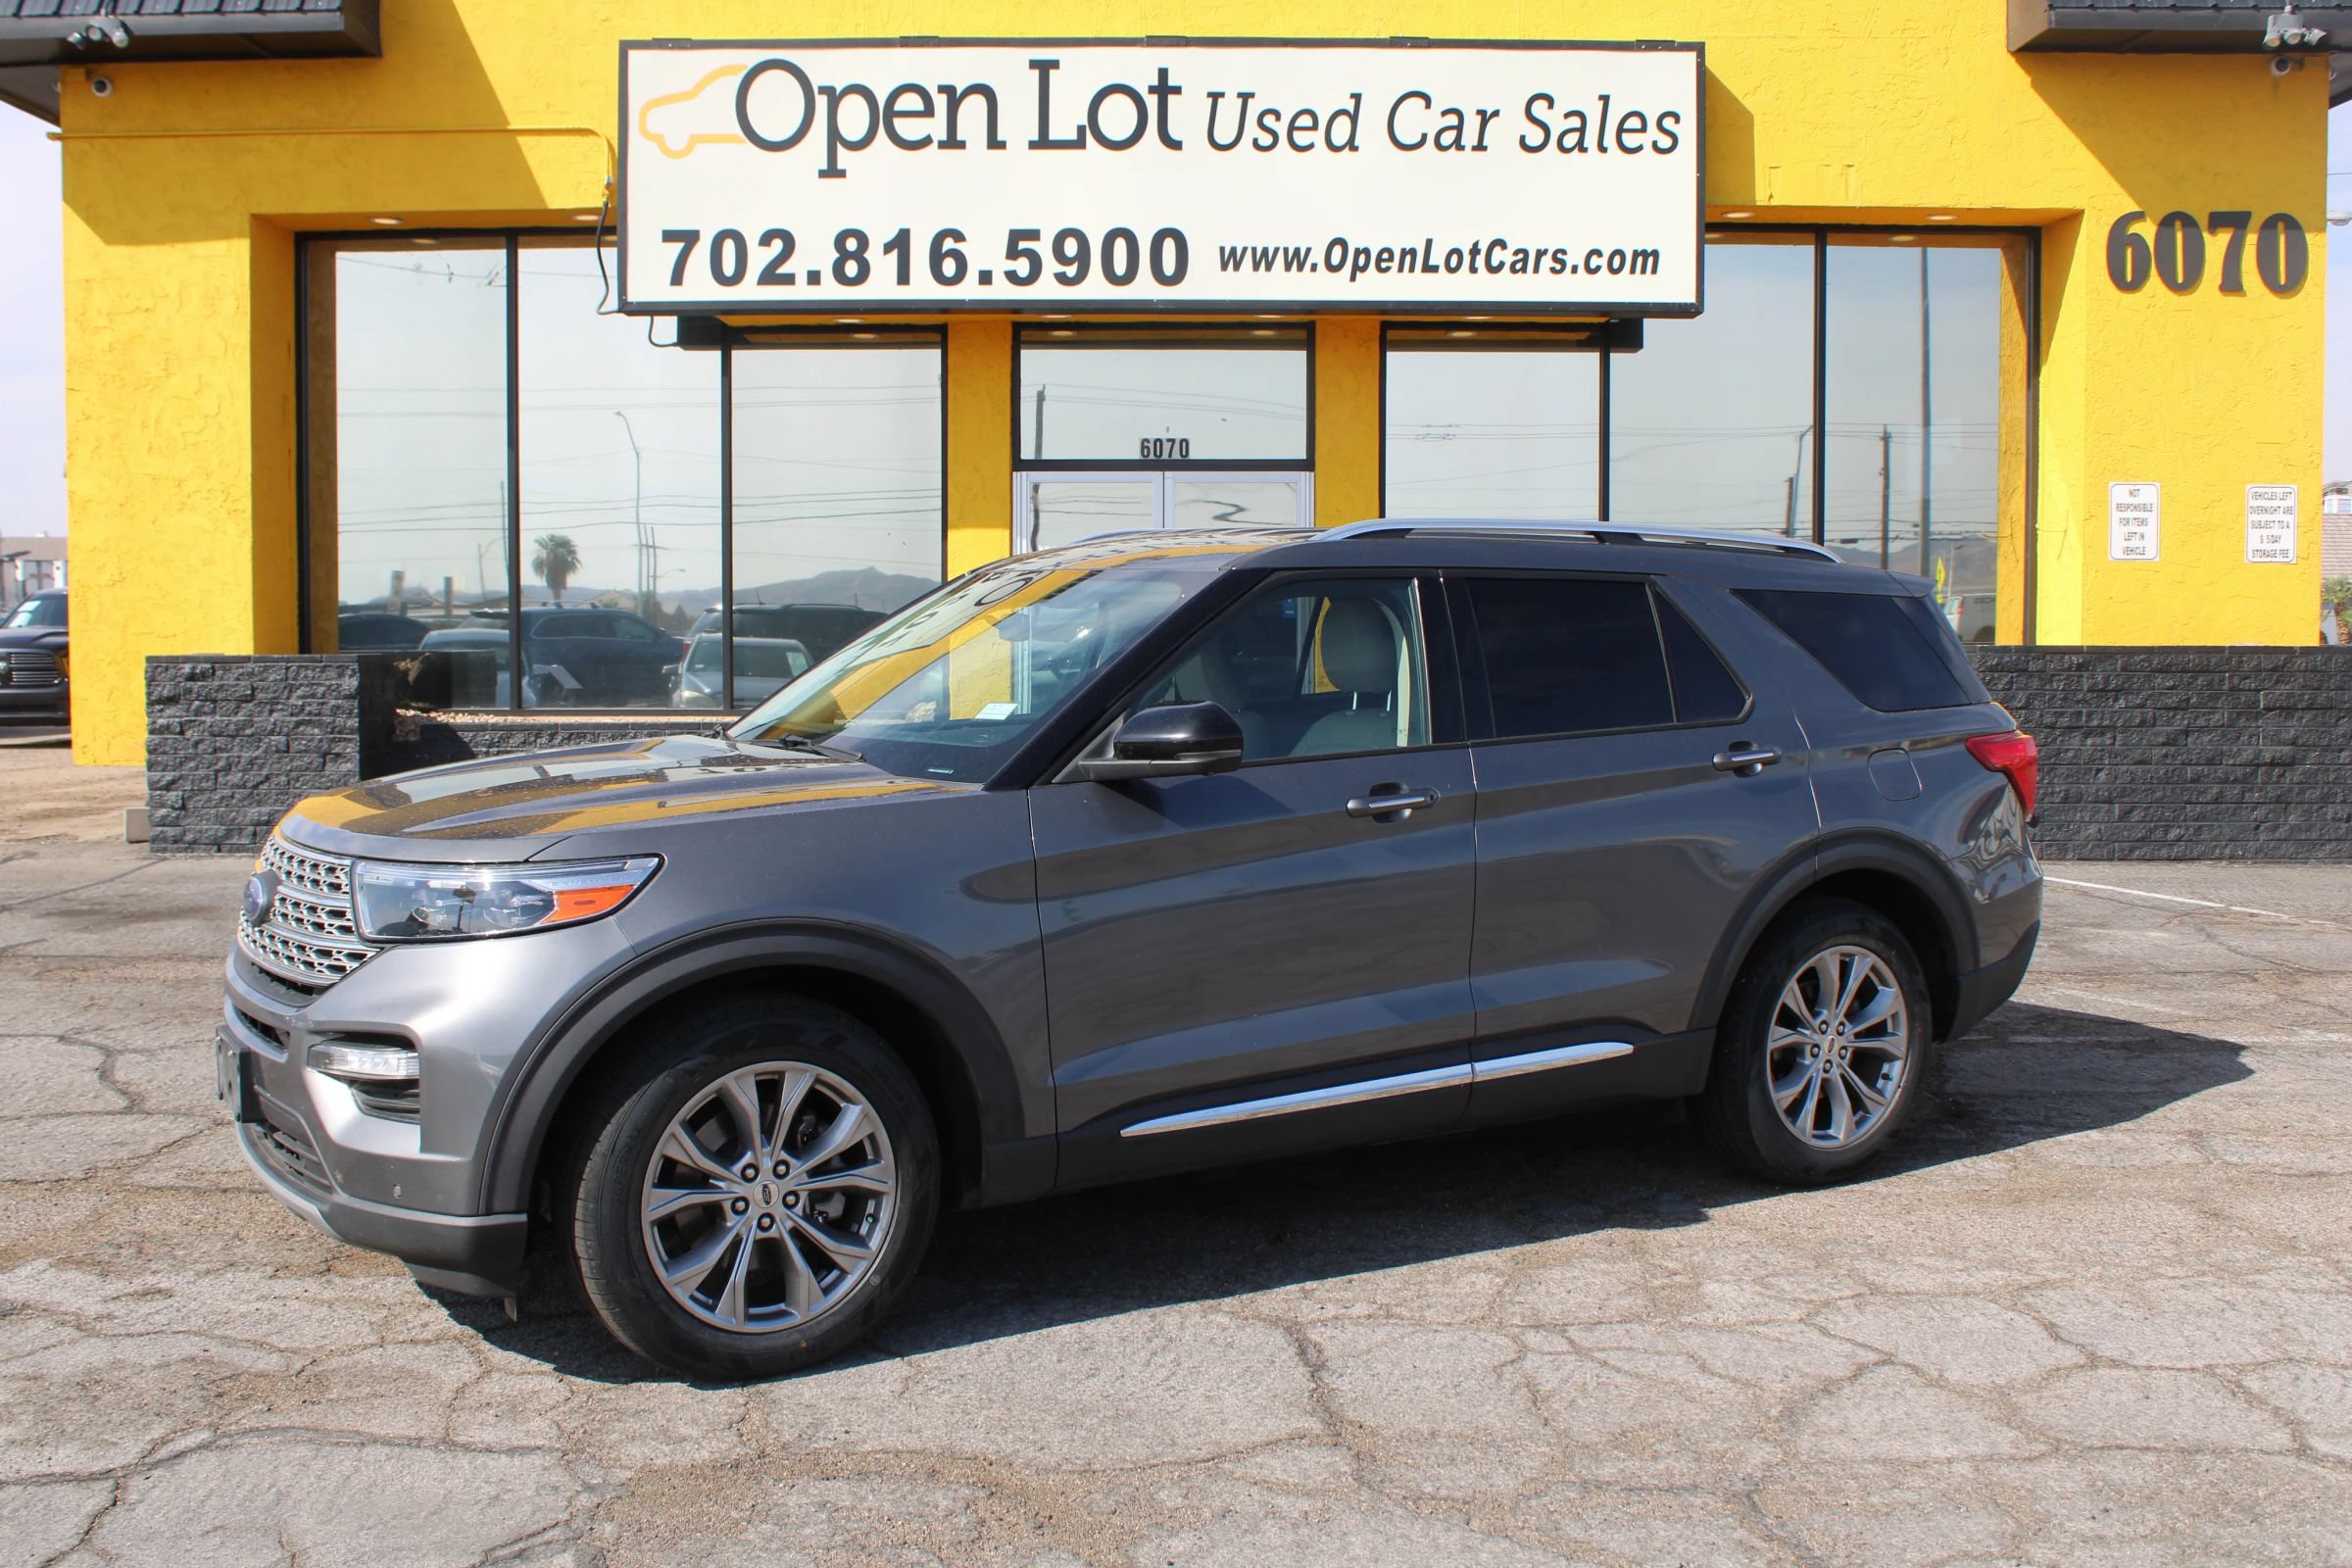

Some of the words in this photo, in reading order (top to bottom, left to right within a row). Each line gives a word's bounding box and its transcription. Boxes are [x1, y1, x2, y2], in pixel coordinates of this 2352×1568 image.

[735, 58, 1006, 178] Open
[1028, 59, 1183, 150] Lot
[1206, 91, 1362, 152] Used
[1387, 90, 1500, 153] Car
[1519, 93, 1681, 154] Sales
[662, 227, 1189, 286] 702.816.5900
[2106, 211, 2308, 294] 6070
[1219, 237, 1660, 282] www.OpenLotCars.com
[1140, 438, 1189, 459] 6070
[2129, 488, 2140, 498] NOT
[2251, 491, 2278, 501] VEHICLES
[2278, 491, 2292, 501] LEFT
[2116, 503, 2153, 513] RESPONSIBLE
[2249, 506, 2281, 514] OVERNIGHT
[2282, 506, 2293, 514] ARE
[2119, 517, 2131, 526] FOR
[2132, 517, 2148, 526] ITEMS
[2251, 520, 2275, 529] SUBJECT
[2278, 520, 2284, 529] TO
[2124, 532, 2137, 541] LEFT
[2123, 547, 2146, 556] VEHICLE
[2252, 549, 2278, 559] STORAGE
[2278, 549, 2289, 559] FEE
